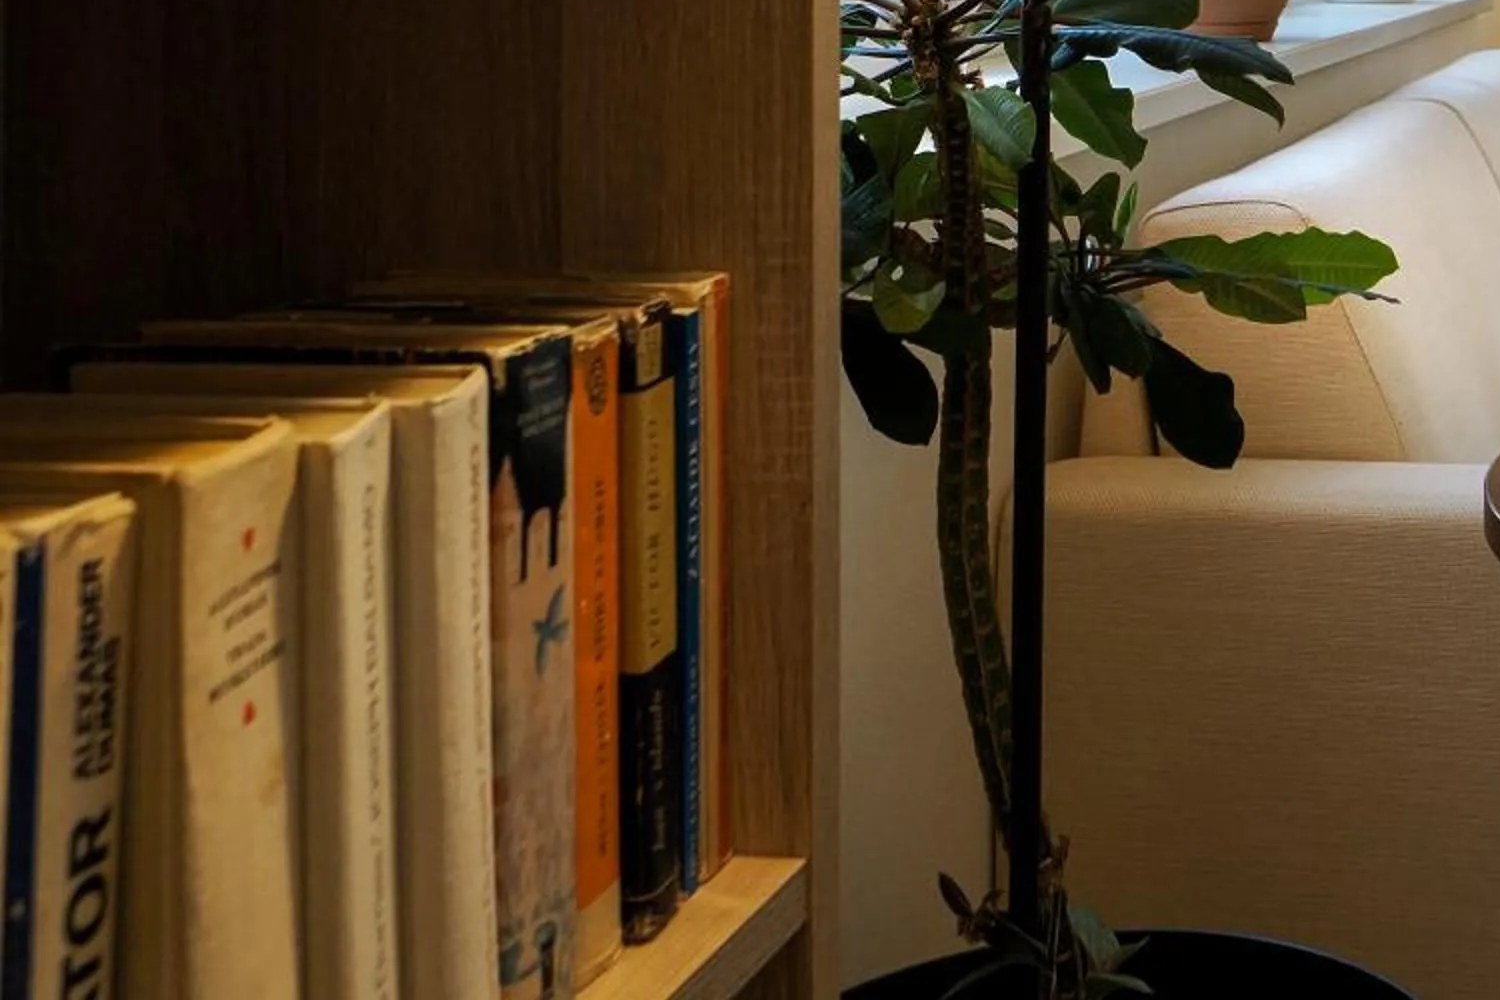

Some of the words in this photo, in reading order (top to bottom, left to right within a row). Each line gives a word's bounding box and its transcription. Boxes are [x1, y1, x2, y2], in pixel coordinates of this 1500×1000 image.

[646, 419, 660, 512] HUGO
[71, 556, 105, 781] ALEXANDER
[96, 635, 121, 774] DUMAS
[60, 808, 114, 1000] TOR
